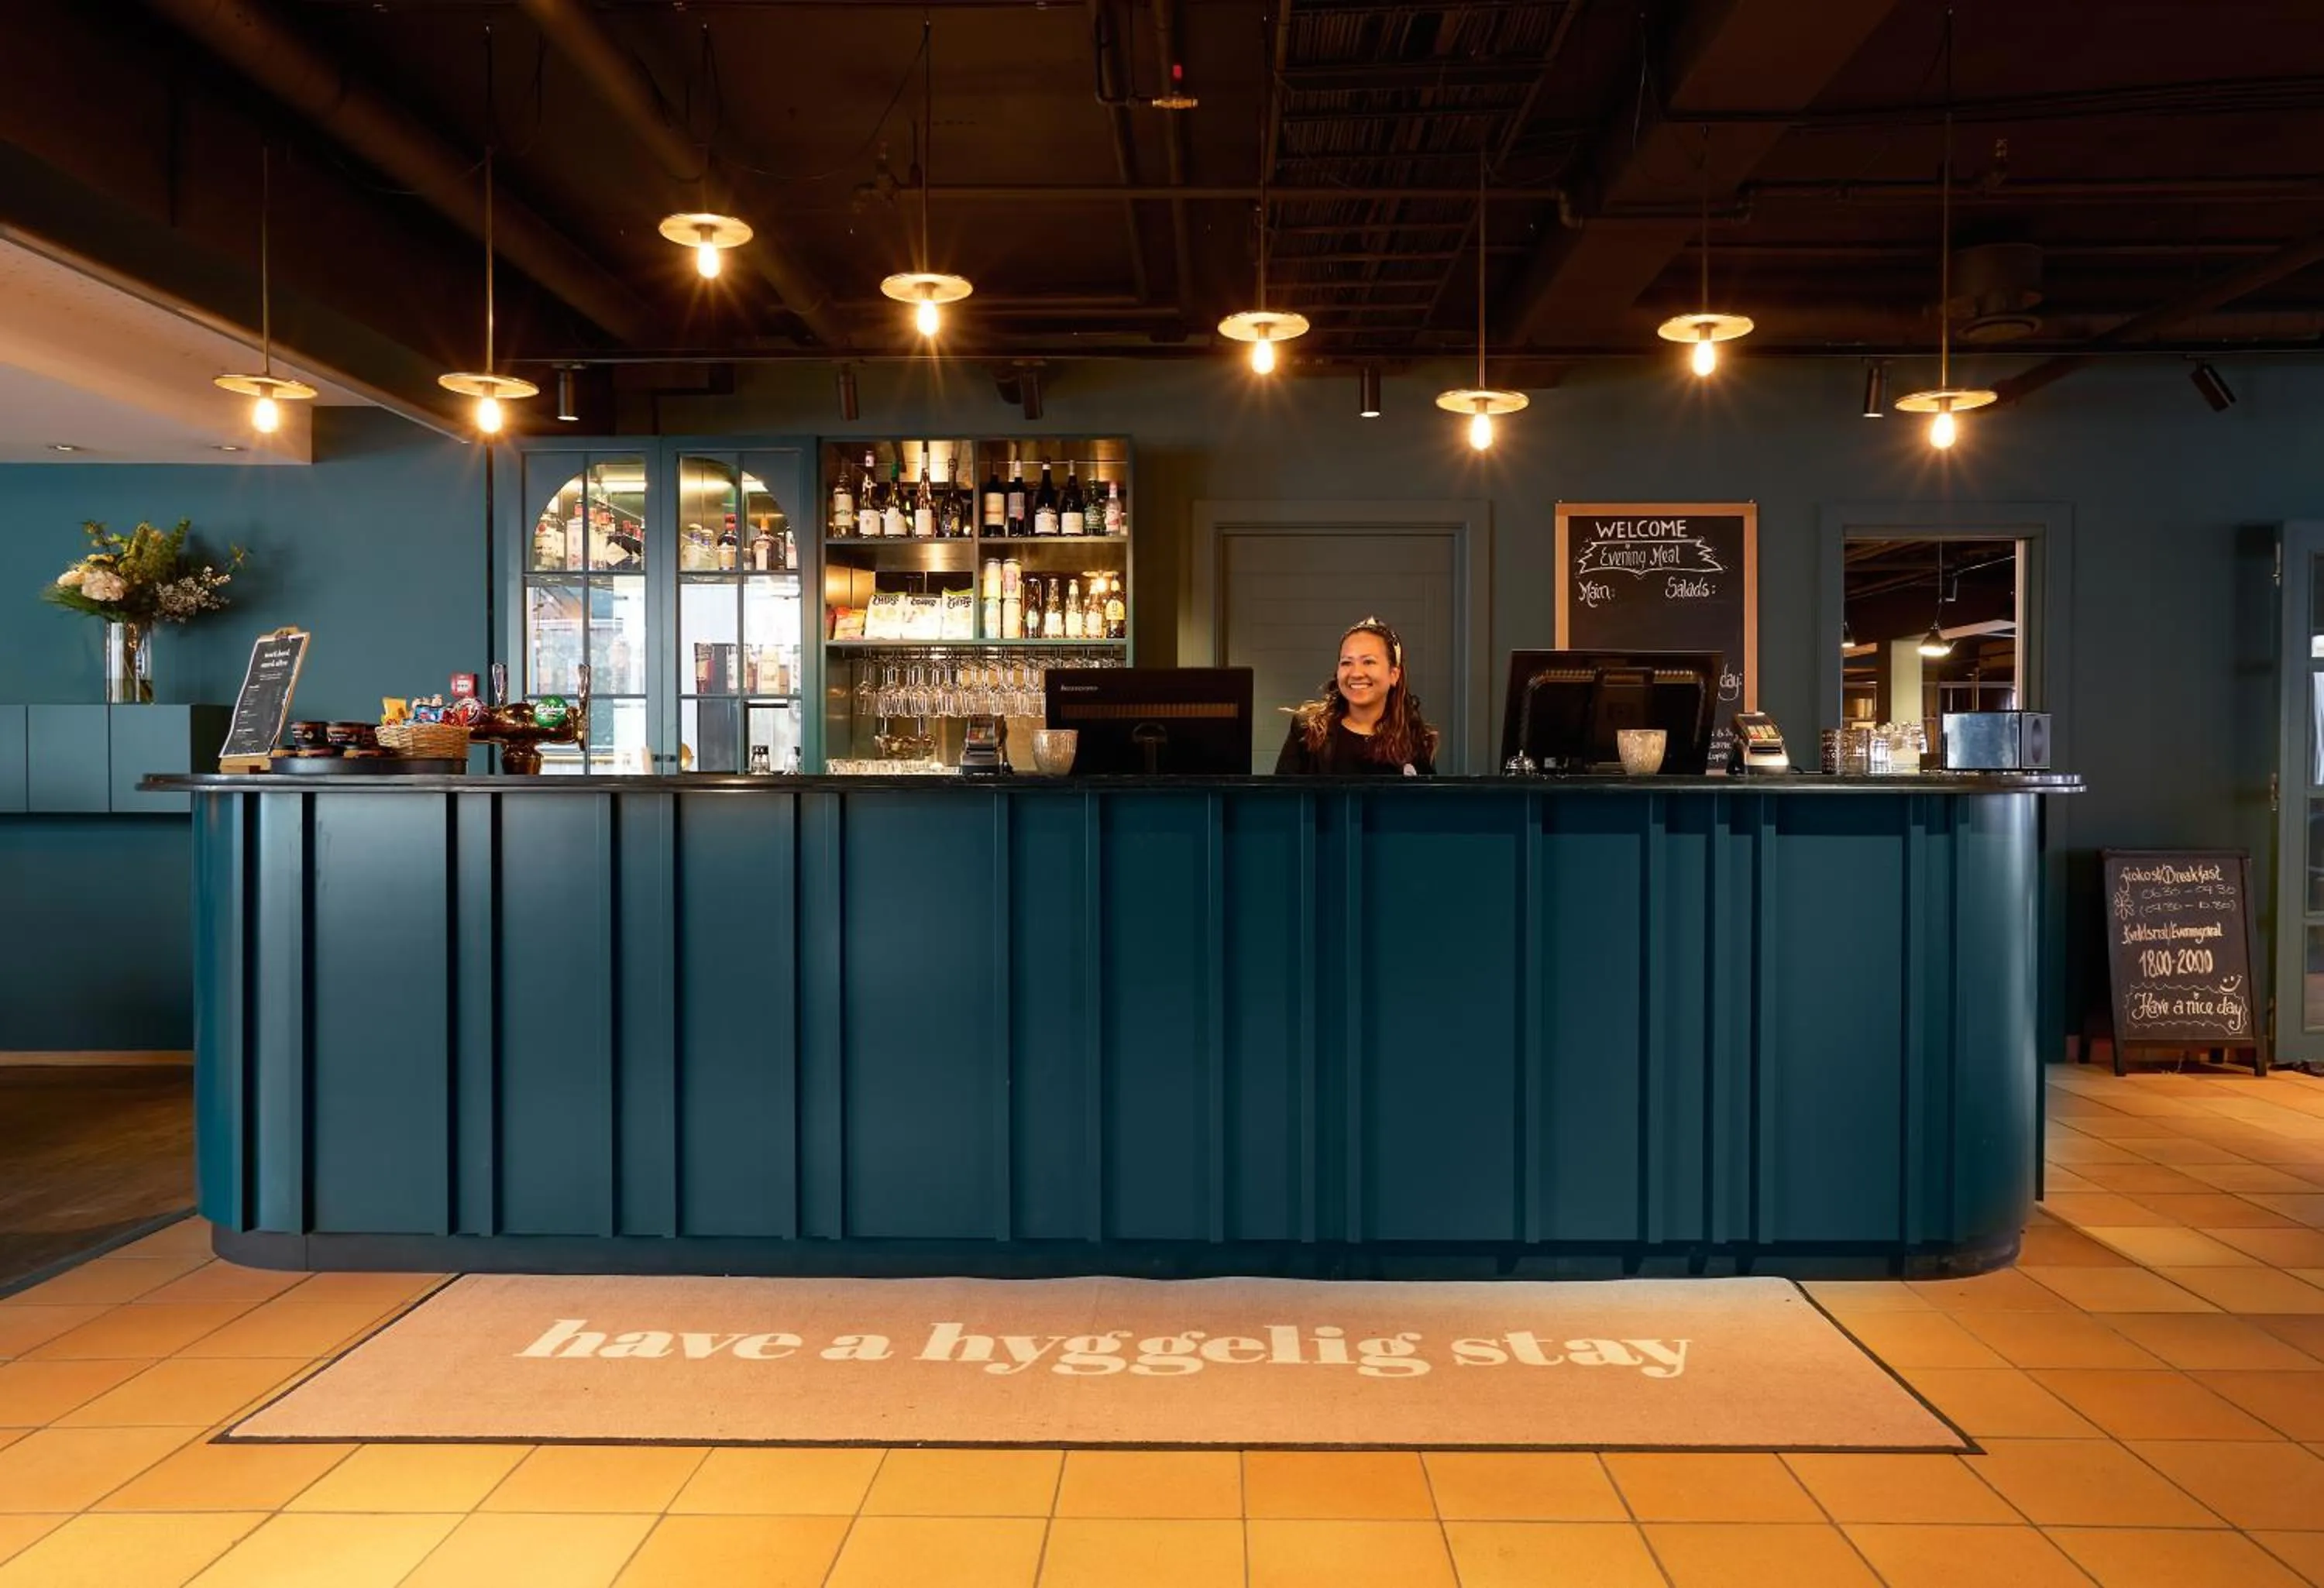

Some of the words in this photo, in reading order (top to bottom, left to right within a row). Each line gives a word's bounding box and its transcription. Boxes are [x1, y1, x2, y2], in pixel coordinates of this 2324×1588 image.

[1595, 520, 1689, 538] WELCOME
[1599, 543, 1647, 569] Evening
[1649, 545, 1680, 568] Meal
[2131, 992, 2170, 1019] Have
[2173, 999, 2184, 1015] a
[2185, 992, 2214, 1016] nice
[2216, 996, 2242, 1030] day
[513, 1318, 803, 1360] have
[819, 1333, 893, 1360] a
[913, 1322, 1432, 1377] hyggelig
[1449, 1330, 1694, 1378] stay
